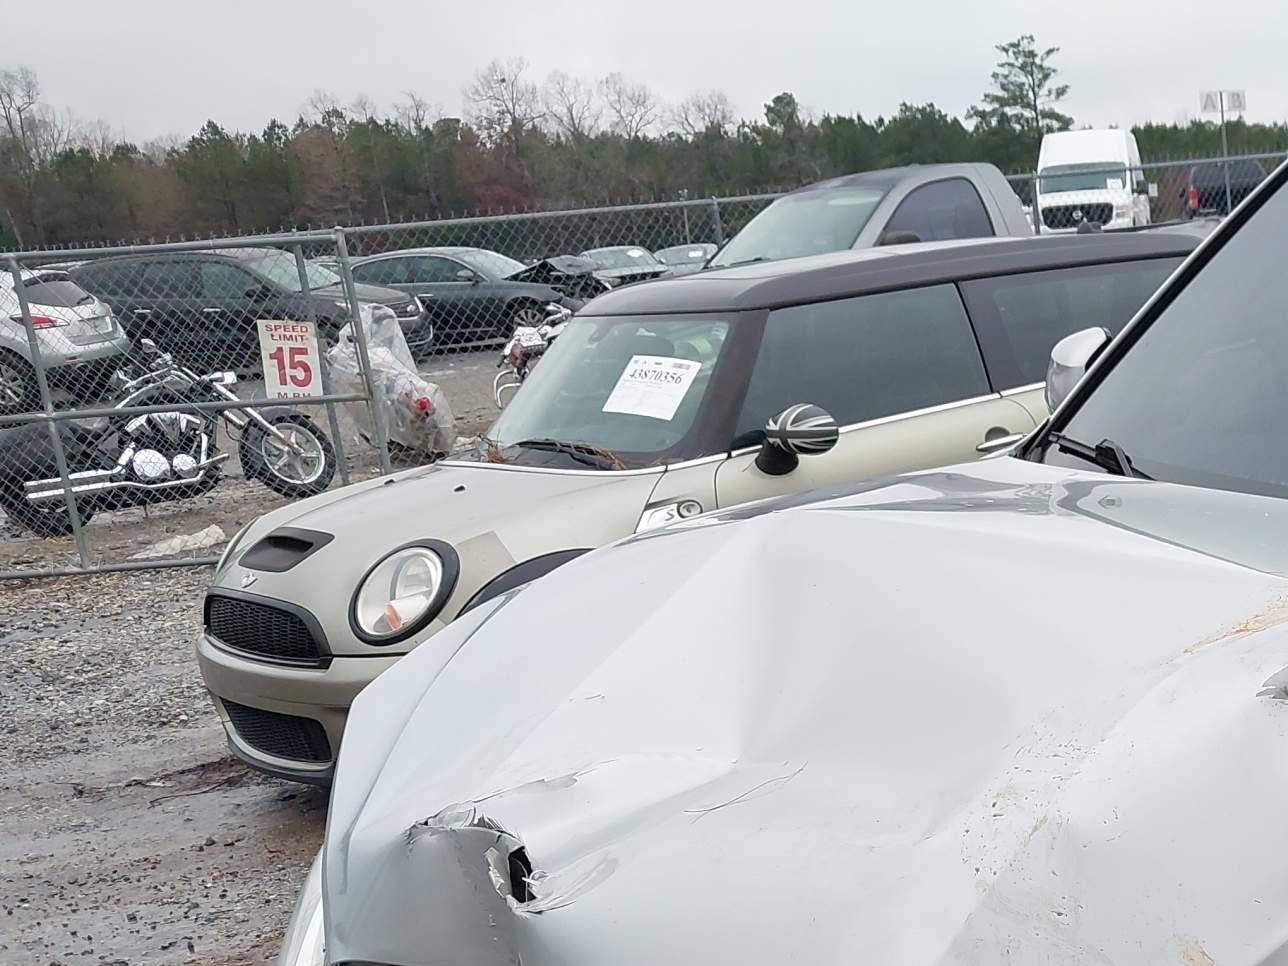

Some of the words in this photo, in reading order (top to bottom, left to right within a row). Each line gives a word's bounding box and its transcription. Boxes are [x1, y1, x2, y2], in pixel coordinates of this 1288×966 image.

[1203, 94, 1216, 110] A
[265, 324, 308, 333] SPEED
[271, 333, 306, 343] LIMIT
[269, 346, 312, 388] 15
[629, 368, 682, 384] 43870356
